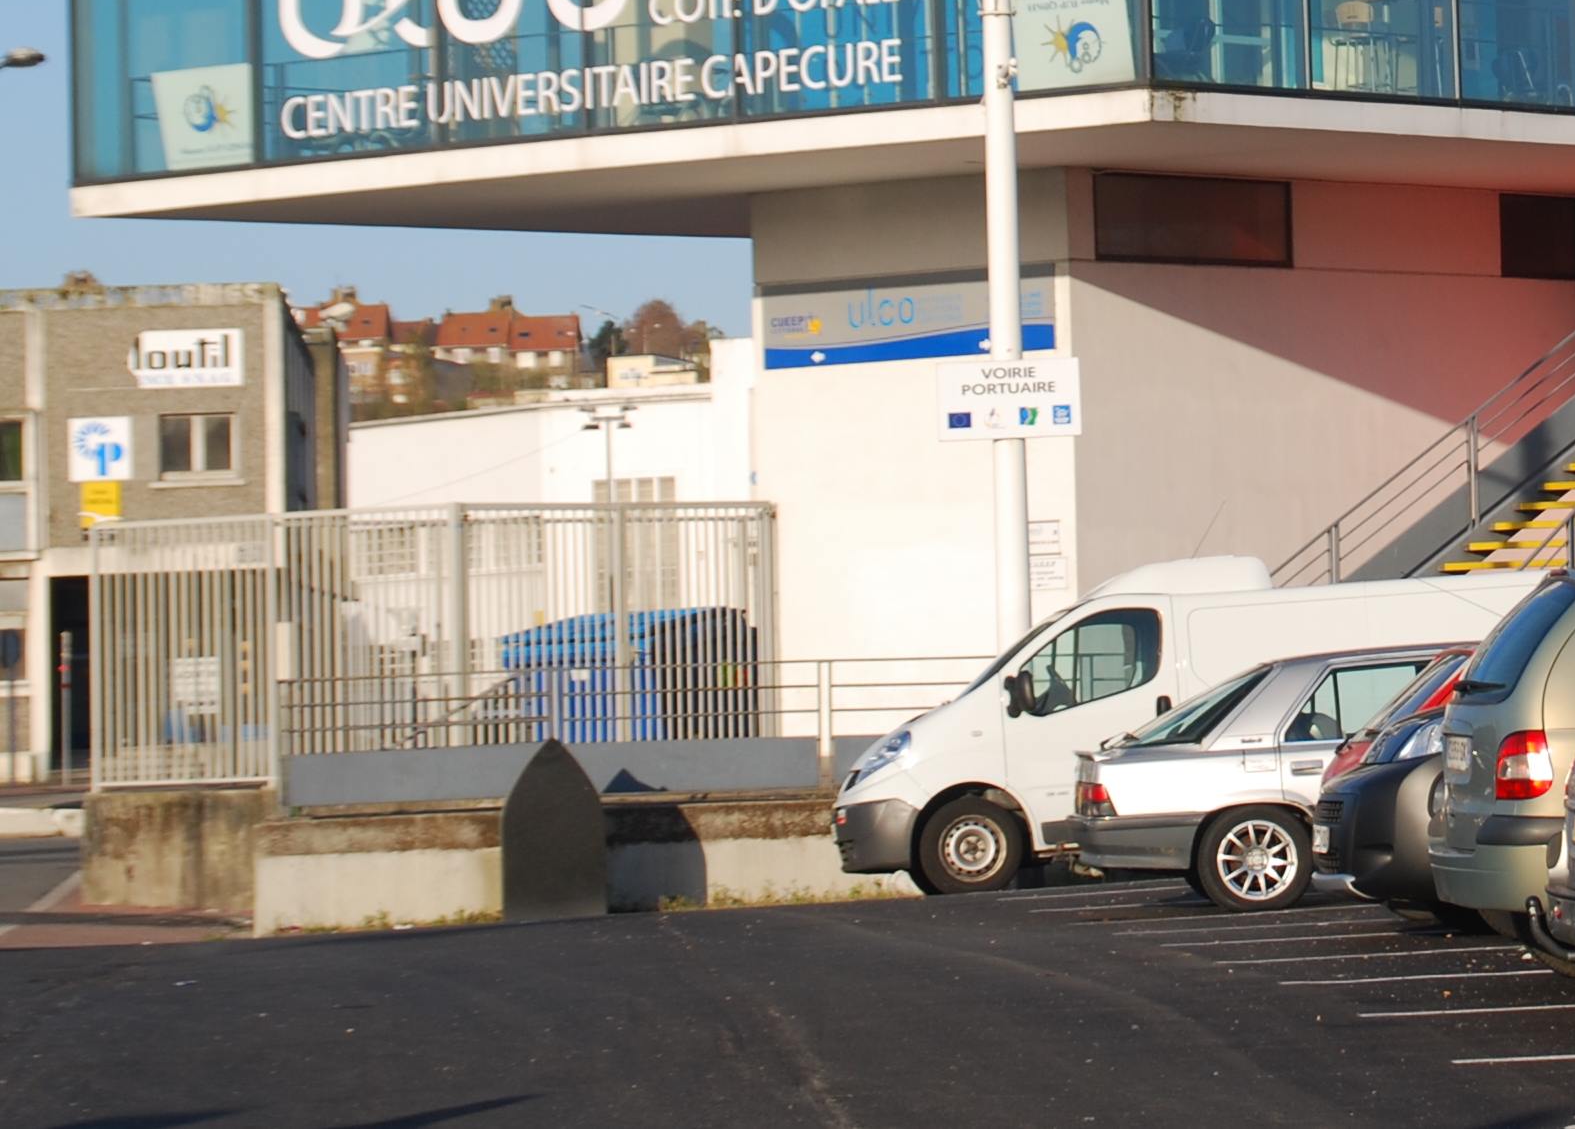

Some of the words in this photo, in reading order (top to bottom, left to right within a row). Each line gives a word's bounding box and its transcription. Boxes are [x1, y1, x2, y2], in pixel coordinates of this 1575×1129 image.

[280, 84, 421, 140] CENTRE
[425, 58, 697, 124] UNIVERSITAIRE
[701, 38, 903, 99] CAPECURE
[981, 366, 1036, 380] VOIRIE
[961, 380, 1056, 396] PORTUAIRE
